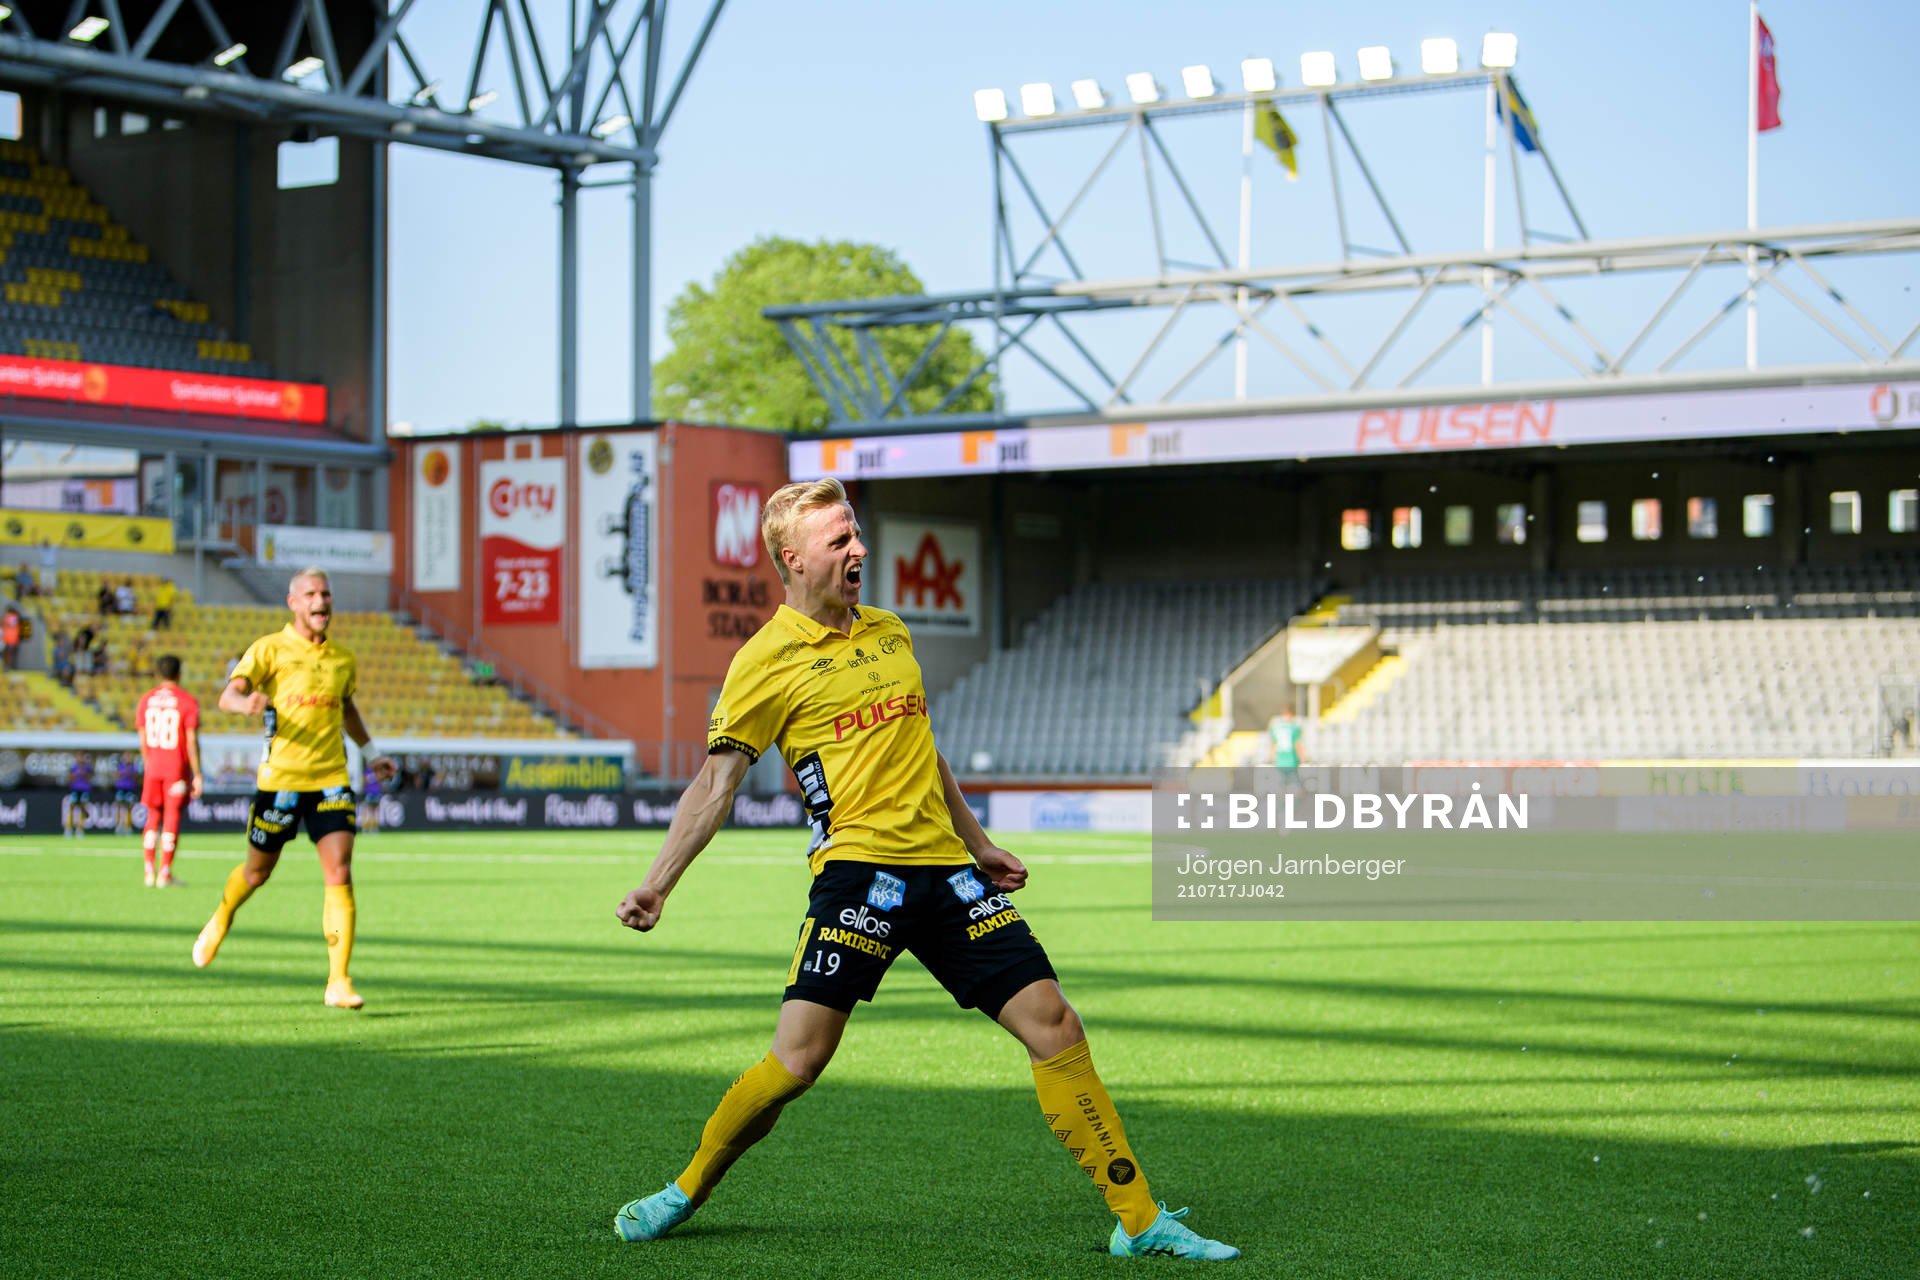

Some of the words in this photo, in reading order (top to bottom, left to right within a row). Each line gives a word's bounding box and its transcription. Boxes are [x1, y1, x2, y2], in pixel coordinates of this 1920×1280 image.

[1356, 400, 1554, 455] PULSEN
[818, 665, 837, 676] umbro
[834, 694, 927, 741] PULSEN
[504, 756, 622, 789] Assemblin
[250, 826, 267, 845] 20
[840, 905, 892, 938] ellos
[968, 893, 1012, 920] ellos
[966, 909, 1021, 941] RAMIRE
[818, 927, 892, 960] RAMIRENT
[812, 950, 841, 976] 19
[1075, 1092, 1117, 1157] VINNERGI
